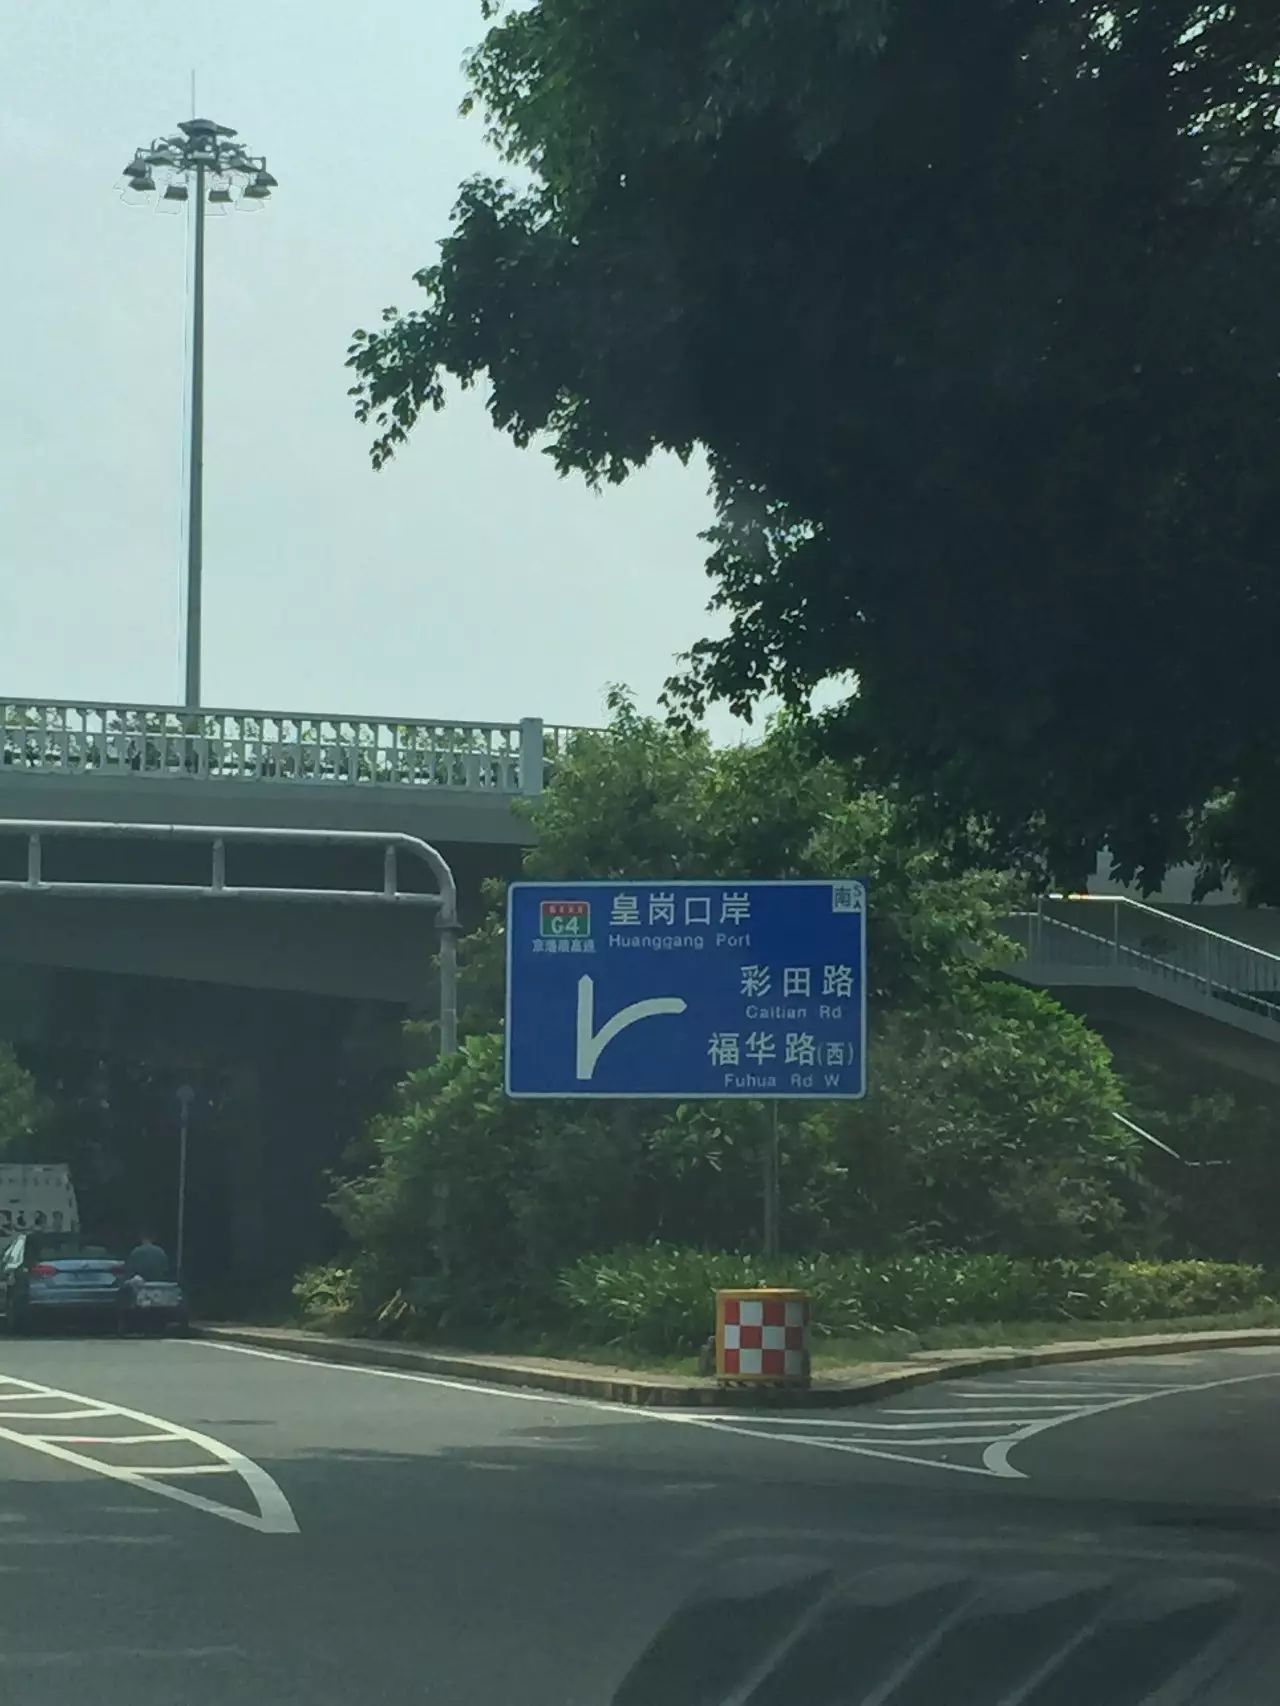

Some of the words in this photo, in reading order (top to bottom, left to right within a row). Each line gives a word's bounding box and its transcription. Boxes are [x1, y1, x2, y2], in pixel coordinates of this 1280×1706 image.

[834, 885, 852, 908] 南
[609, 892, 751, 926] 皇岗口岸
[551, 916, 579, 935] G4
[608, 934, 704, 951] Huanggang
[716, 933, 751, 947] Port
[740, 965, 855, 998] 彩田路
[745, 1005, 807, 1019] Caitian
[820, 1005, 842, 1019] Rd
[725, 1074, 777, 1088] Fuhua
[791, 1073, 814, 1087] Rd
[824, 1074, 840, 1088] W
